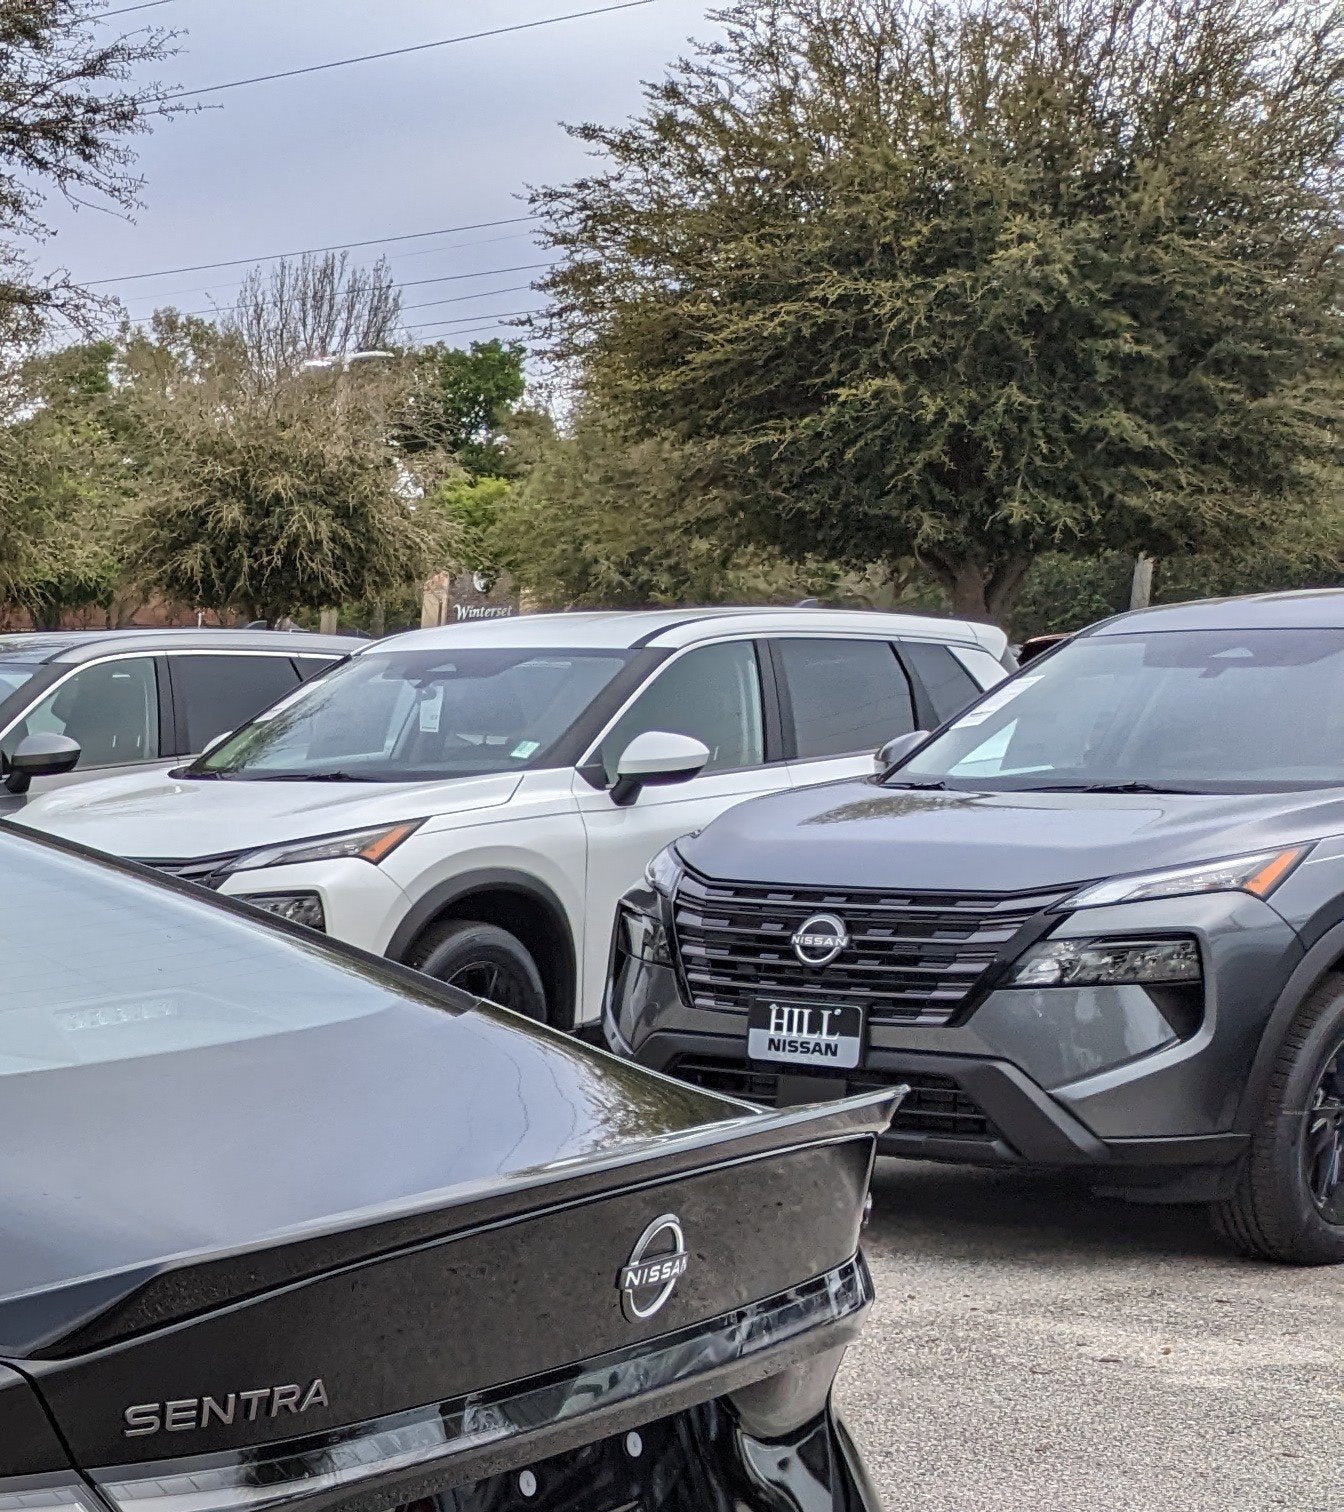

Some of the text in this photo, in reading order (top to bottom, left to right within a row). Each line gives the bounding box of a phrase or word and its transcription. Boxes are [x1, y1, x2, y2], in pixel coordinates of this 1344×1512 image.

[453, 604, 512, 620] Winterset
[791, 935, 848, 947] NISSAN
[769, 1003, 841, 1040] HILL
[767, 1038, 839, 1057] NISSAN
[624, 1257, 688, 1287] NISSAN
[124, 1378, 330, 1437] SENTRA
